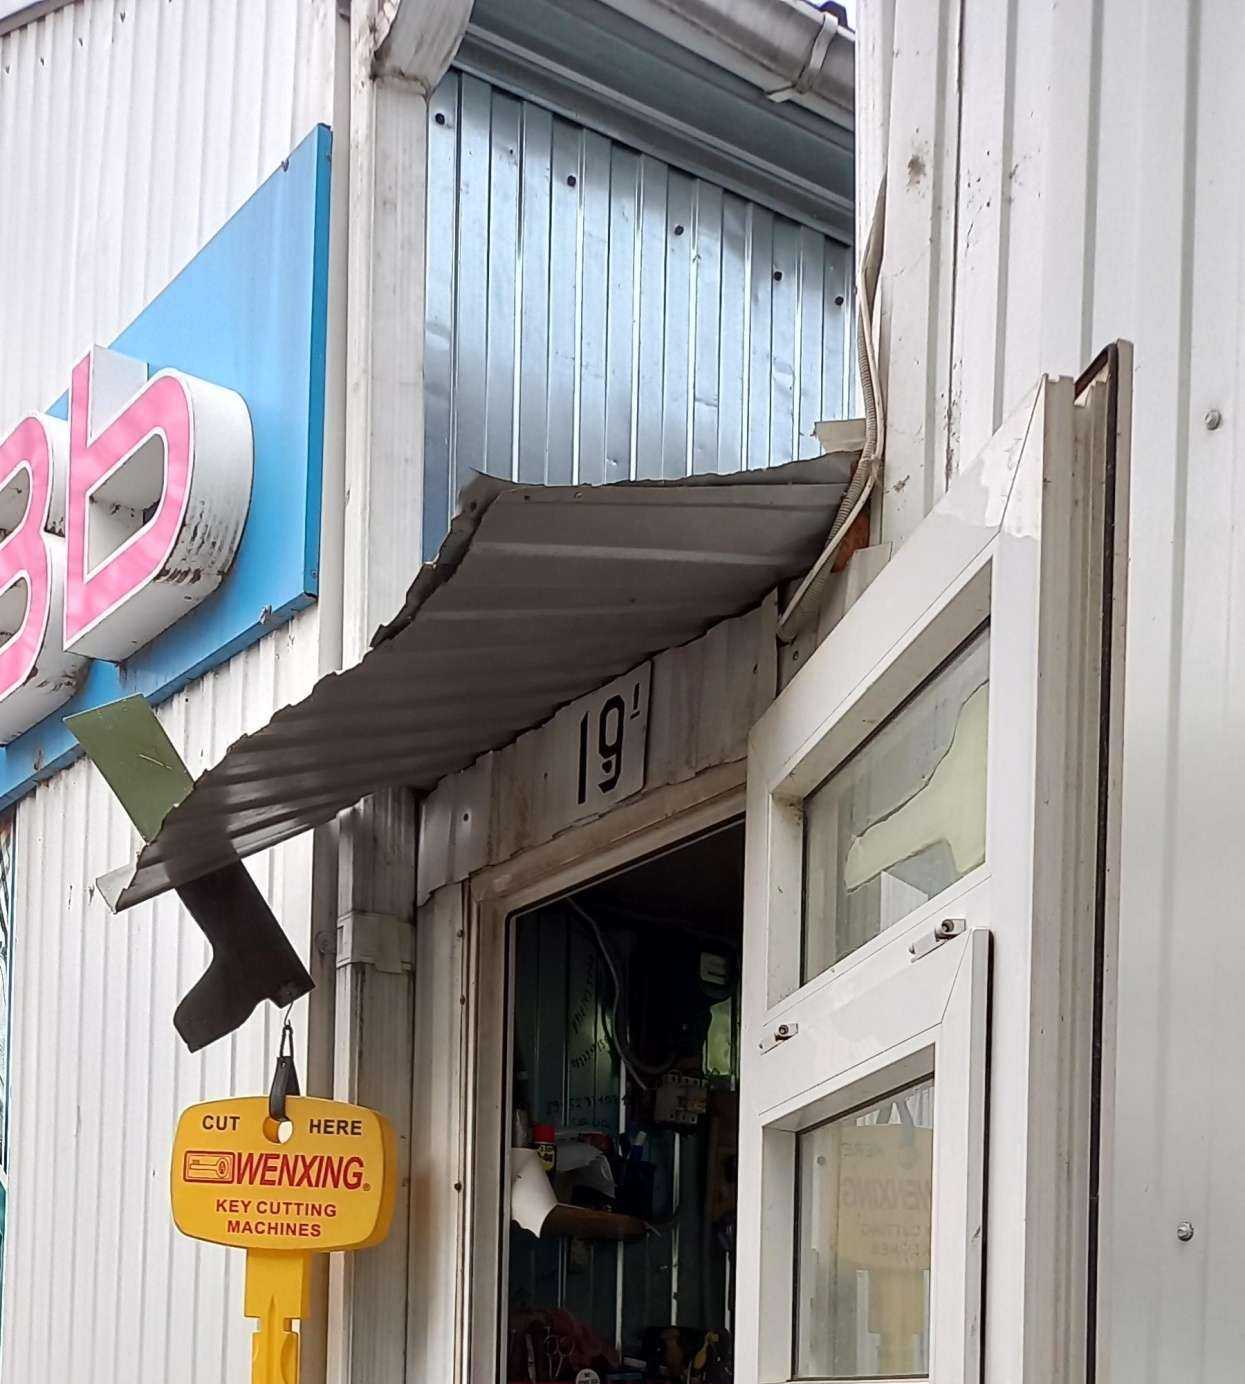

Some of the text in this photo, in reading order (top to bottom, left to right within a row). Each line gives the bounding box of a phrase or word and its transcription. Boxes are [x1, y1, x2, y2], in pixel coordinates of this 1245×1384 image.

[202, 1115, 362, 1135] CUT HERE
[216, 1199, 337, 1217] KEY CUTTING
[227, 1220, 321, 1237] MACHINES
